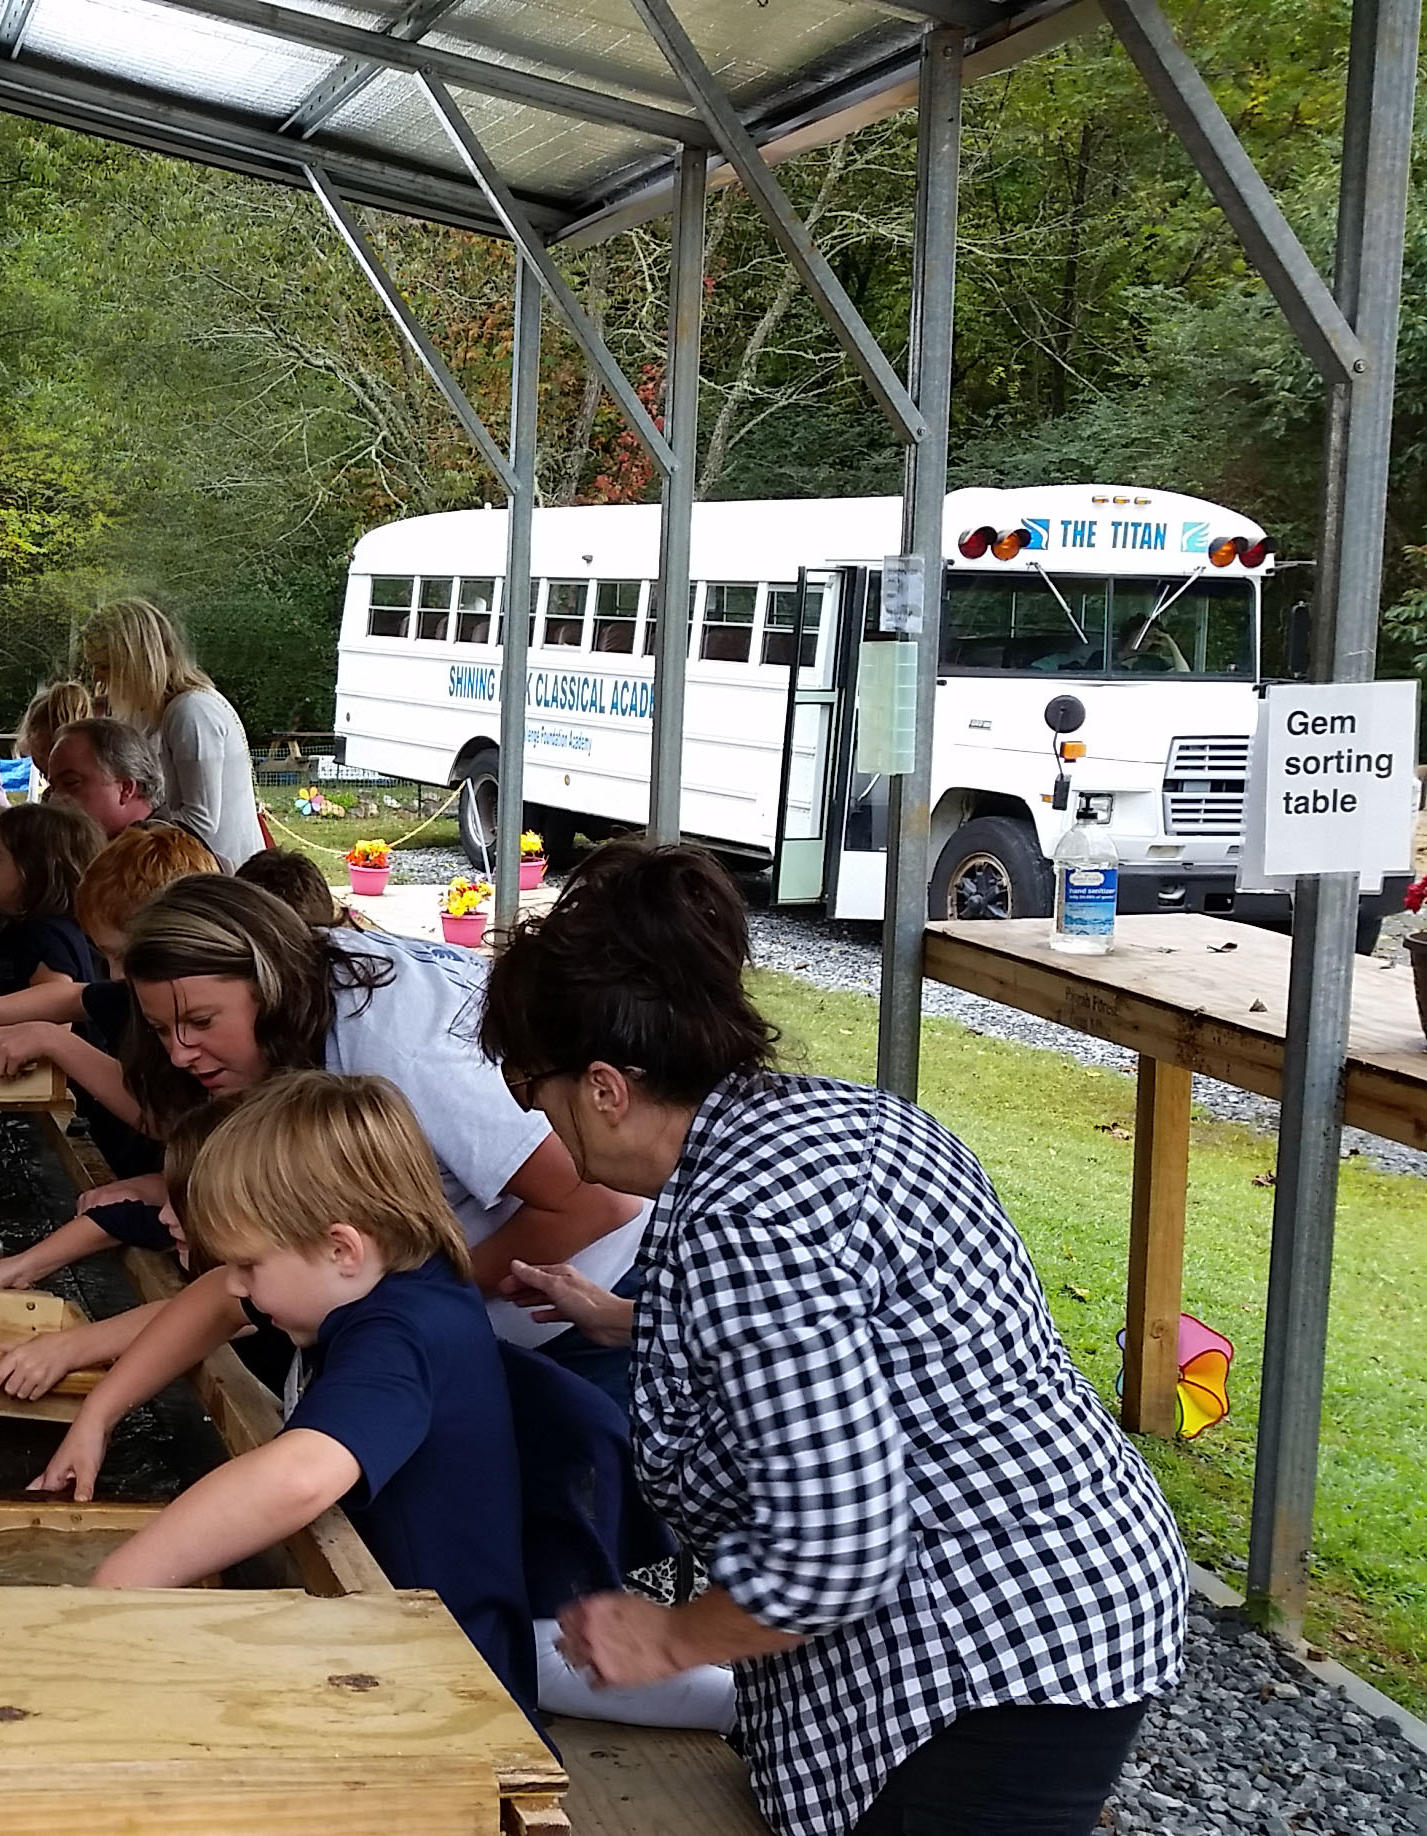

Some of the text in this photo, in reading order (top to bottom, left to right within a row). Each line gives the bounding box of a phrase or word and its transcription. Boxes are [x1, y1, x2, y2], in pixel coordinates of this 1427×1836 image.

[1060, 520, 1168, 551] THE TITAN
[448, 664, 496, 702] SHINING
[535, 673, 606, 714] CLASSICAL
[609, 679, 655, 719] ACADE
[1286, 710, 1357, 736] Gem
[1284, 747, 1394, 780] sorting
[1282, 788, 1358, 815] table
